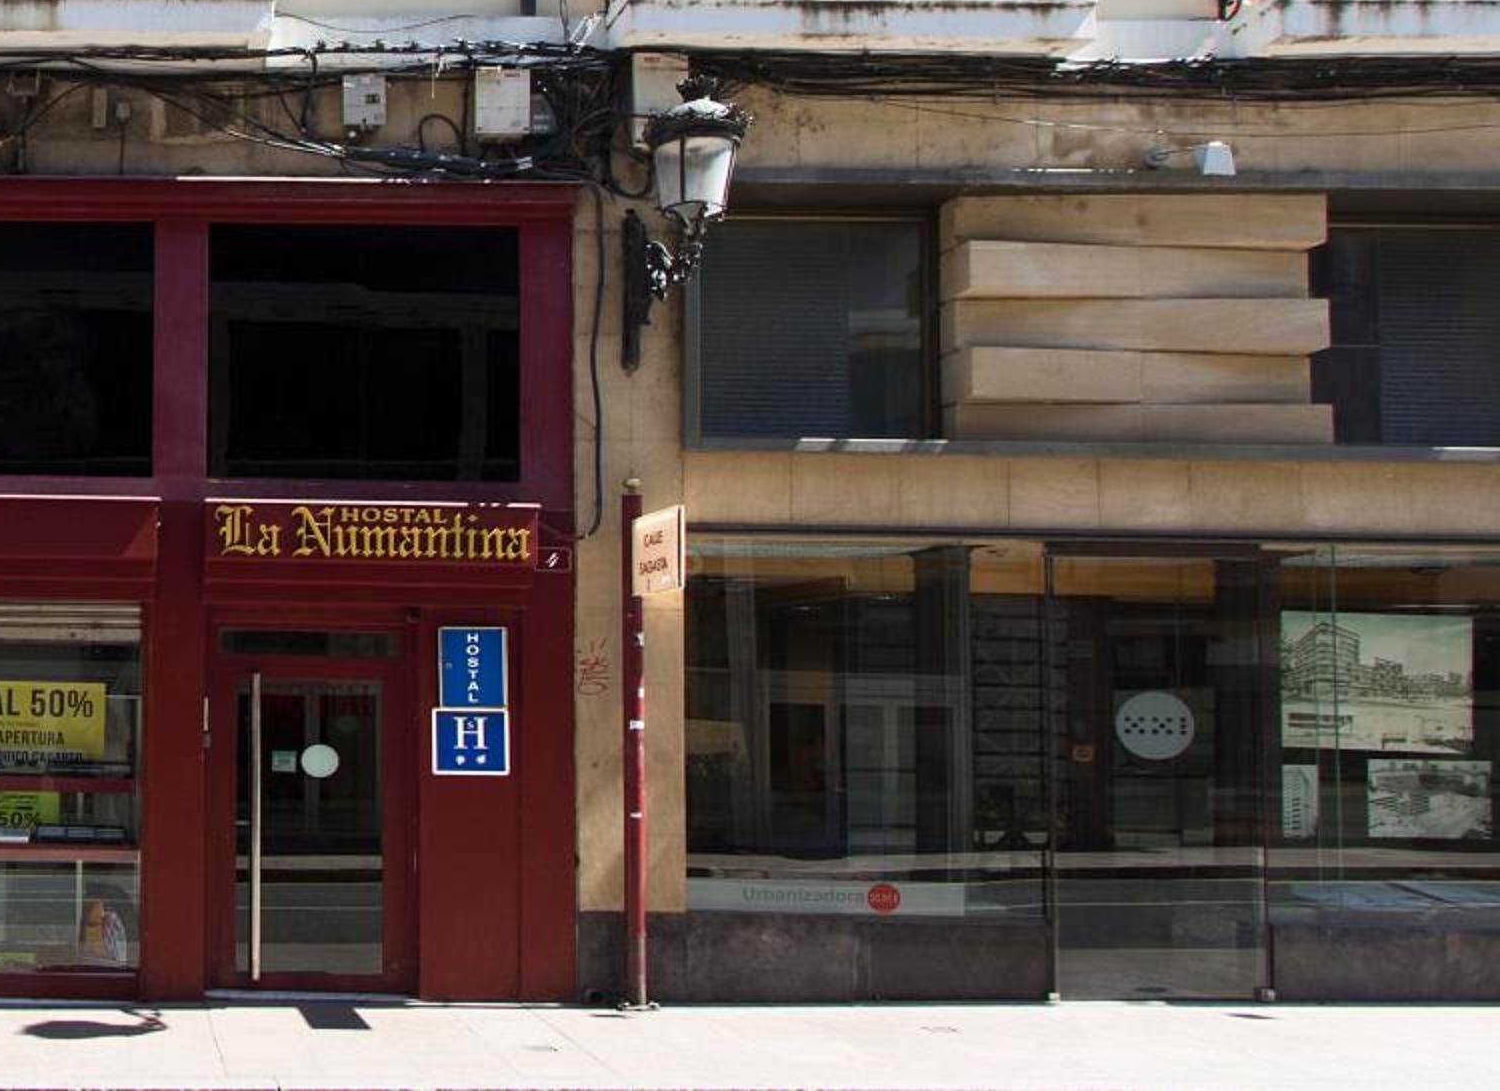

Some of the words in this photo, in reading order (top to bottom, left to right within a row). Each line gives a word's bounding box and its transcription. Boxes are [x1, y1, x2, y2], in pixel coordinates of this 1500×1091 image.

[340, 508, 448, 524] HOSTAL
[214, 505, 281, 556] La
[291, 505, 532, 560] Numantina
[465, 632, 480, 704] HOSTAL
[30, 688, 94, 719] 50%
[742, 887, 865, 903] Urbanizadora
